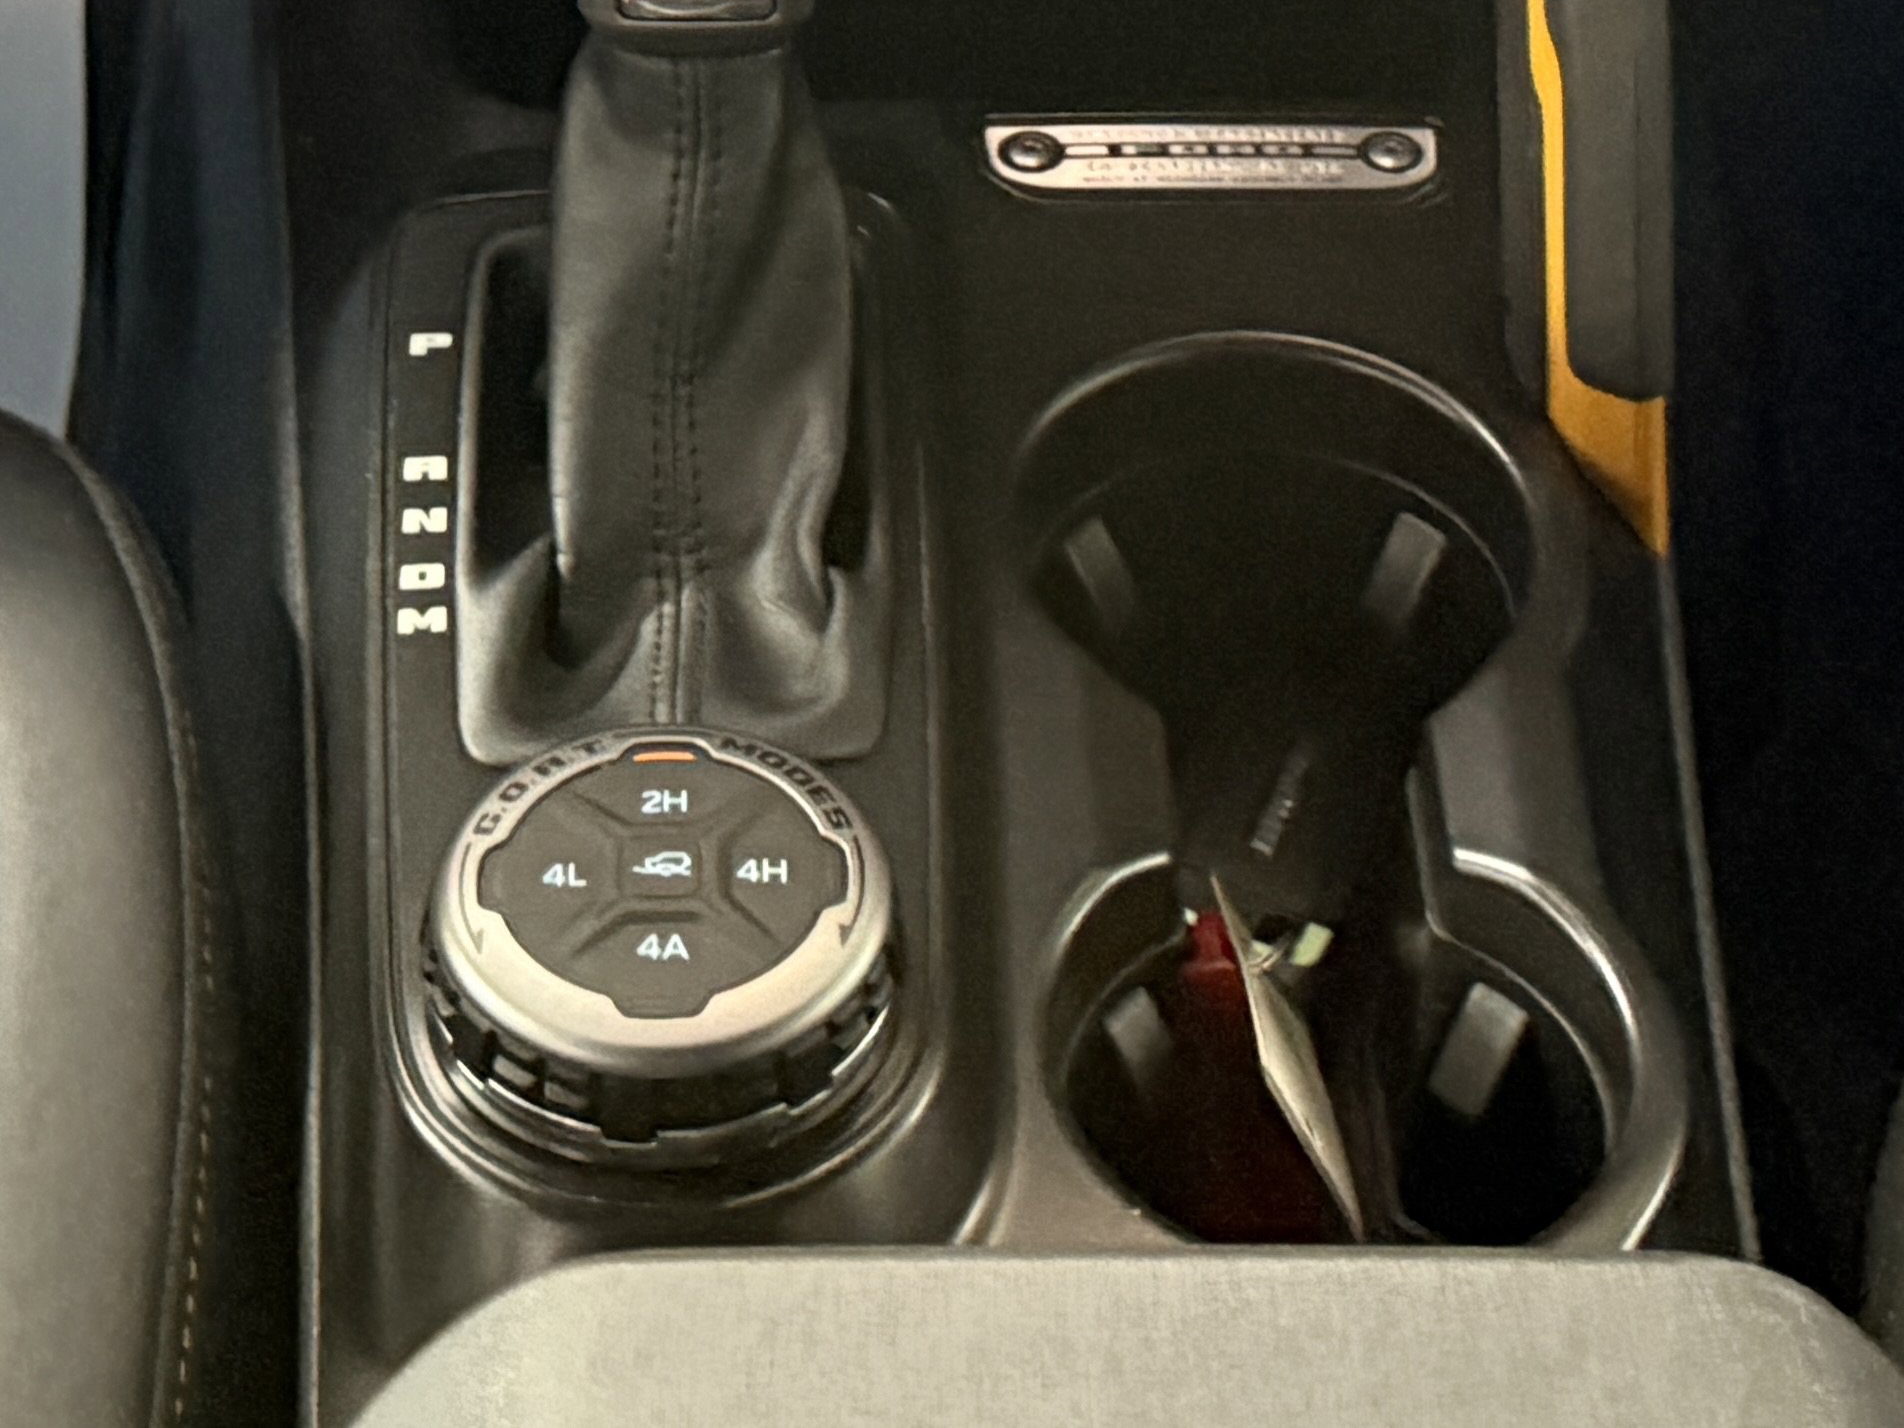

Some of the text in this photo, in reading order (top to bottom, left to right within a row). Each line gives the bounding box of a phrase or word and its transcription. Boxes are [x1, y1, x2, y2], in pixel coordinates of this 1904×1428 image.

[409, 332, 453, 356] P
[401, 507, 448, 534] N
[397, 606, 448, 634] M
[720, 738, 852, 833] MODES
[641, 790, 689, 813] 2H
[542, 863, 587, 888] 4L
[736, 859, 788, 884] 4H
[636, 934, 690, 961] 4A
